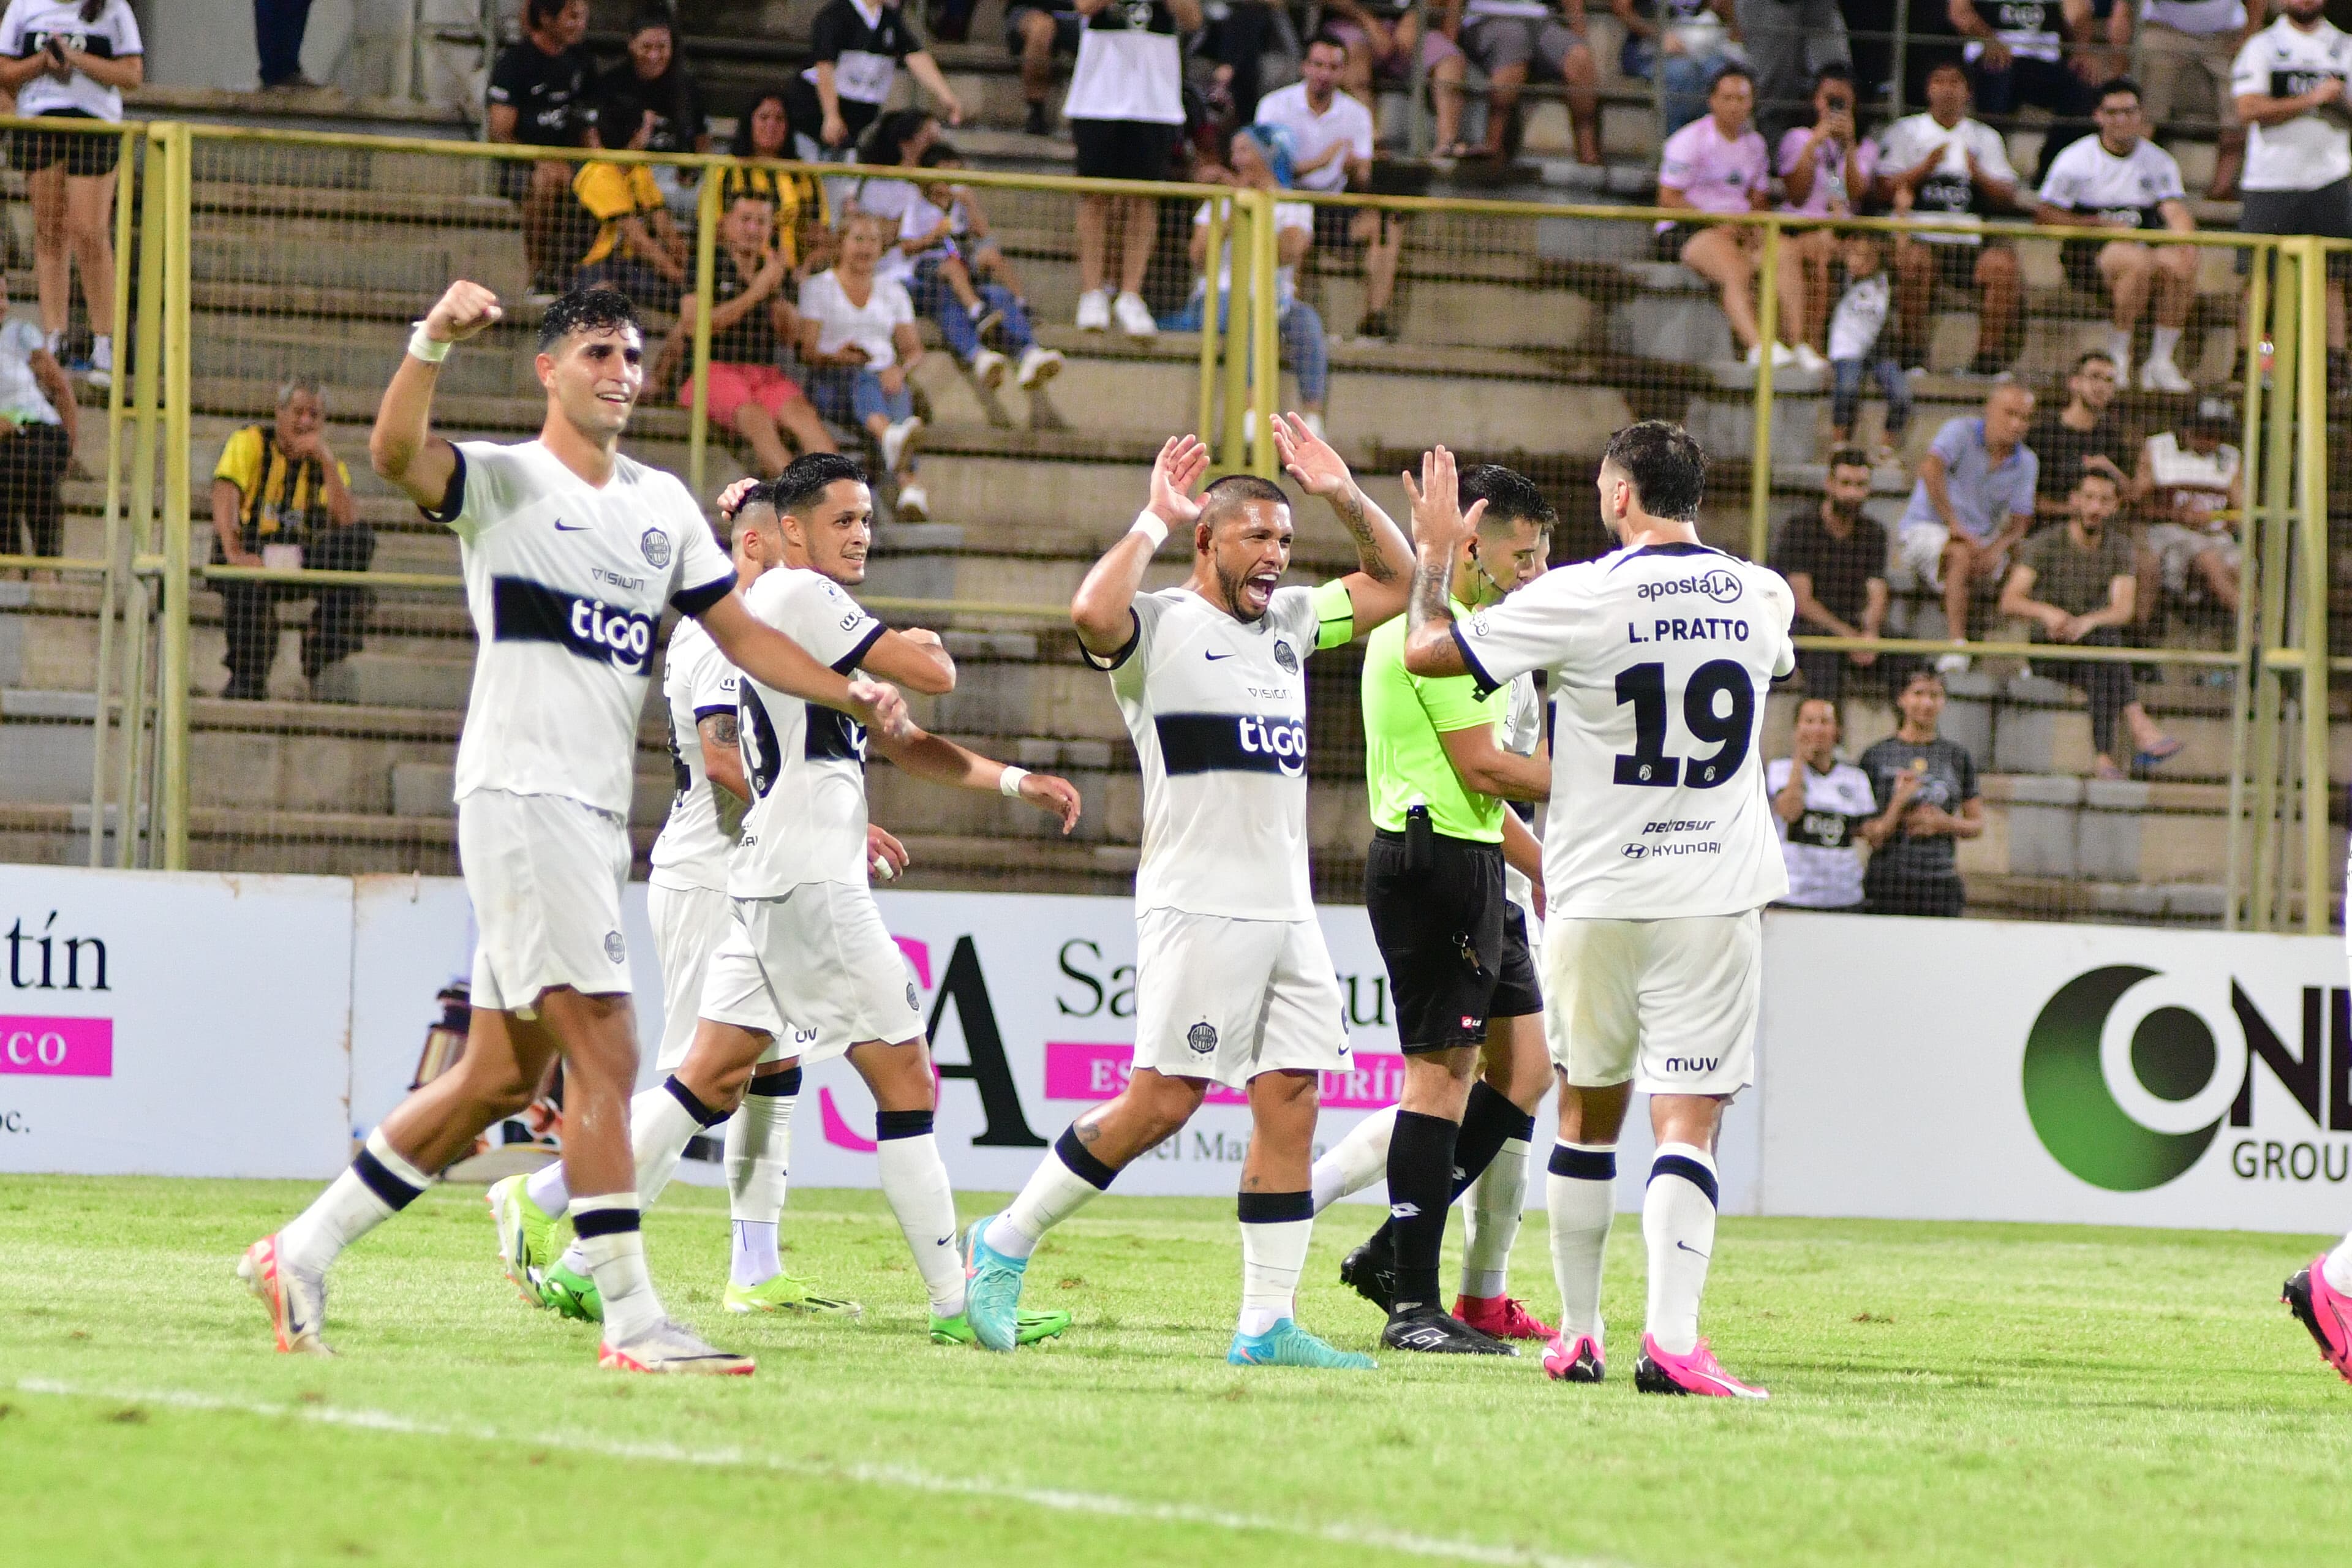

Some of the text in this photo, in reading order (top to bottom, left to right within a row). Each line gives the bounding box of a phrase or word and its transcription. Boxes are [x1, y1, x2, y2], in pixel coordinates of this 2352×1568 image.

[592, 567, 645, 592] VISION
[572, 599, 652, 674] tigo
[1628, 617, 1750, 644] L. PRATTO
[1248, 687, 1293, 699] VISION
[1613, 658, 1755, 790] 19
[1239, 715, 1307, 778] tigo
[1641, 819, 1717, 835] petrosur
[1652, 842, 1722, 857] HYUNDAI
[0, 909, 111, 991] tín
[1056, 938, 1137, 1018] Sa
[795, 1026, 818, 1043] uv
[1666, 1057, 1719, 1072] muv
